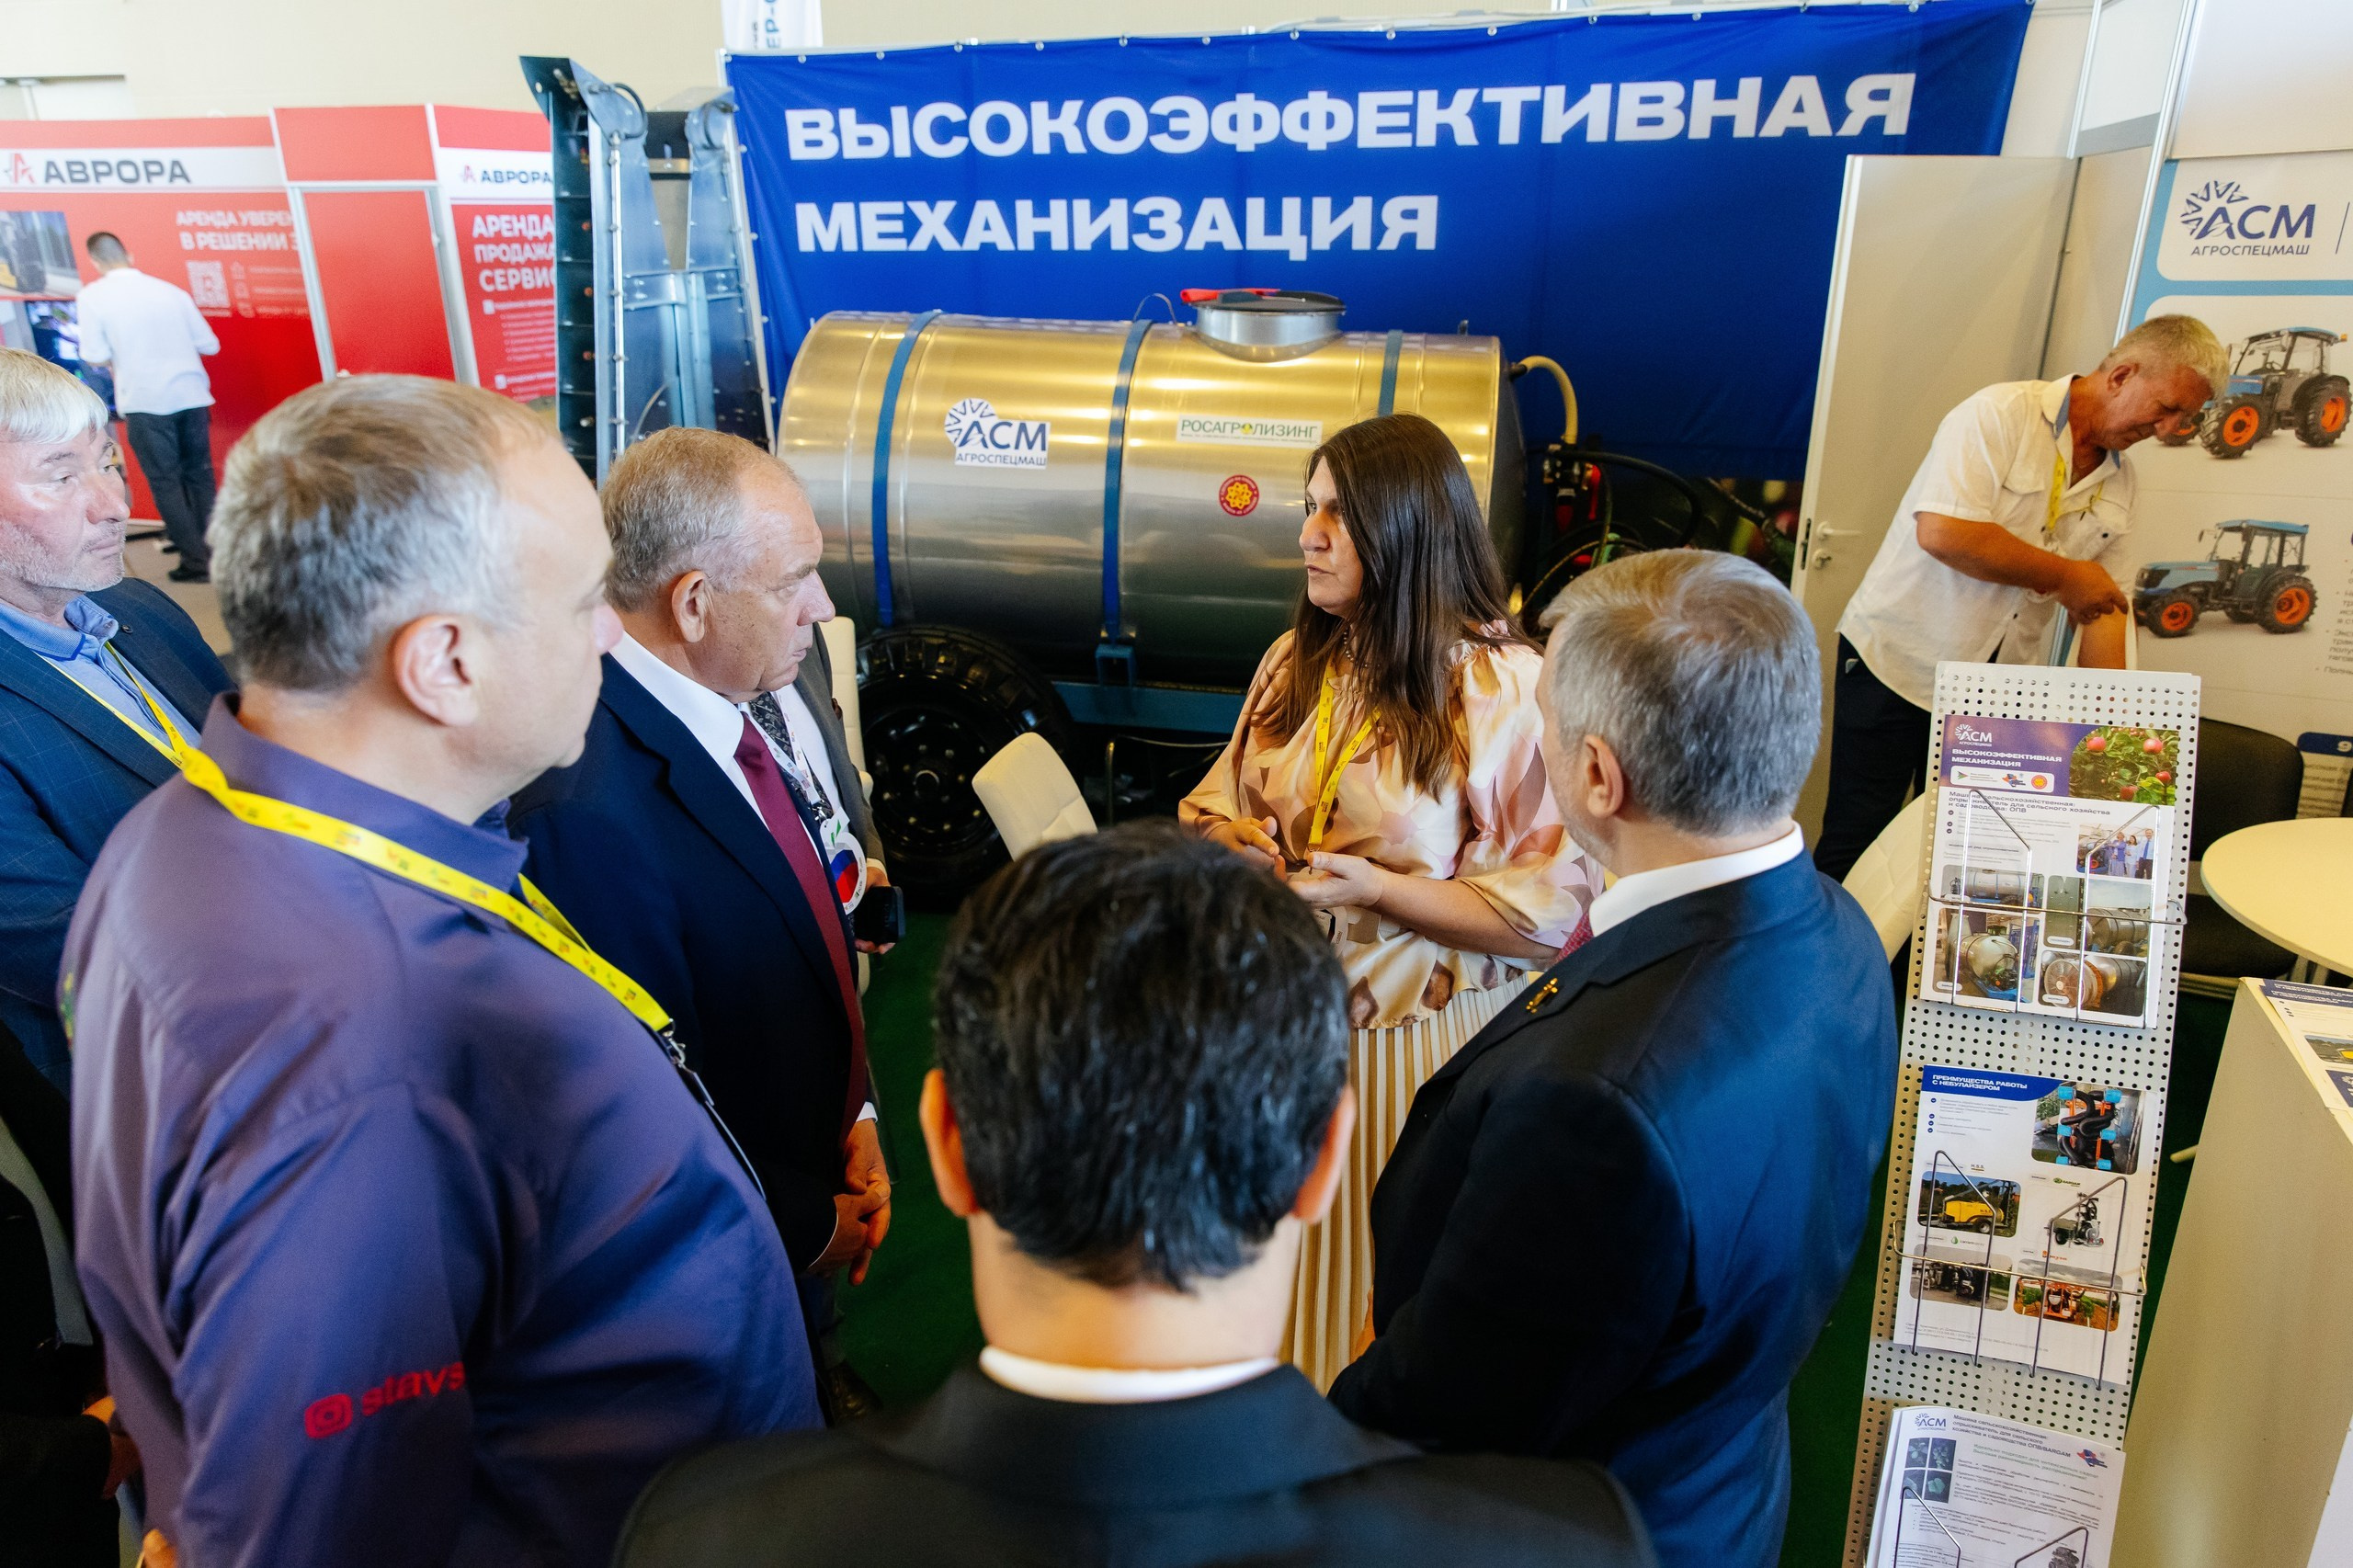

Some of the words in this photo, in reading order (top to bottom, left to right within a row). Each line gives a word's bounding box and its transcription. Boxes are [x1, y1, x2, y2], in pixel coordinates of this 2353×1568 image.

[784, 73, 1916, 161] ВЫСОКОЭФФЕКТИВНАЯ
[45, 160, 191, 184] АВРОРА
[481, 170, 553, 184] АВРОРА
[176, 210, 238, 228] АРЕНДА
[472, 214, 554, 240] АРЕНДА
[795, 195, 1438, 261] МЕХАНИЗАЦИЯ
[2195, 204, 2315, 240] АСМ
[179, 232, 195, 250] В
[196, 232, 288, 250] РЕШЕНИИ
[2190, 244, 2310, 257] АГРОСПЕЦМАШ
[959, 420, 1047, 451] АСМ
[1181, 419, 1317, 437] РОСАГРОЛИЗИНГ
[957, 453, 1046, 466] АГРОСПЕЦМАШ
[1959, 732, 1993, 743] АСМ
[1951, 757, 2021, 767] МЕХАНИЗАЦИЯ
[1952, 749, 2062, 762] ВЫСОКОЭФФЕКТИВНАЯ
[1933, 1074, 1994, 1085] ПРЕИМУЩЕСТВА
[1995, 1081, 2028, 1089] РАБОТЫ
[1939, 1081, 2000, 1091] НЕБУЛАЙЗЕРОМ
